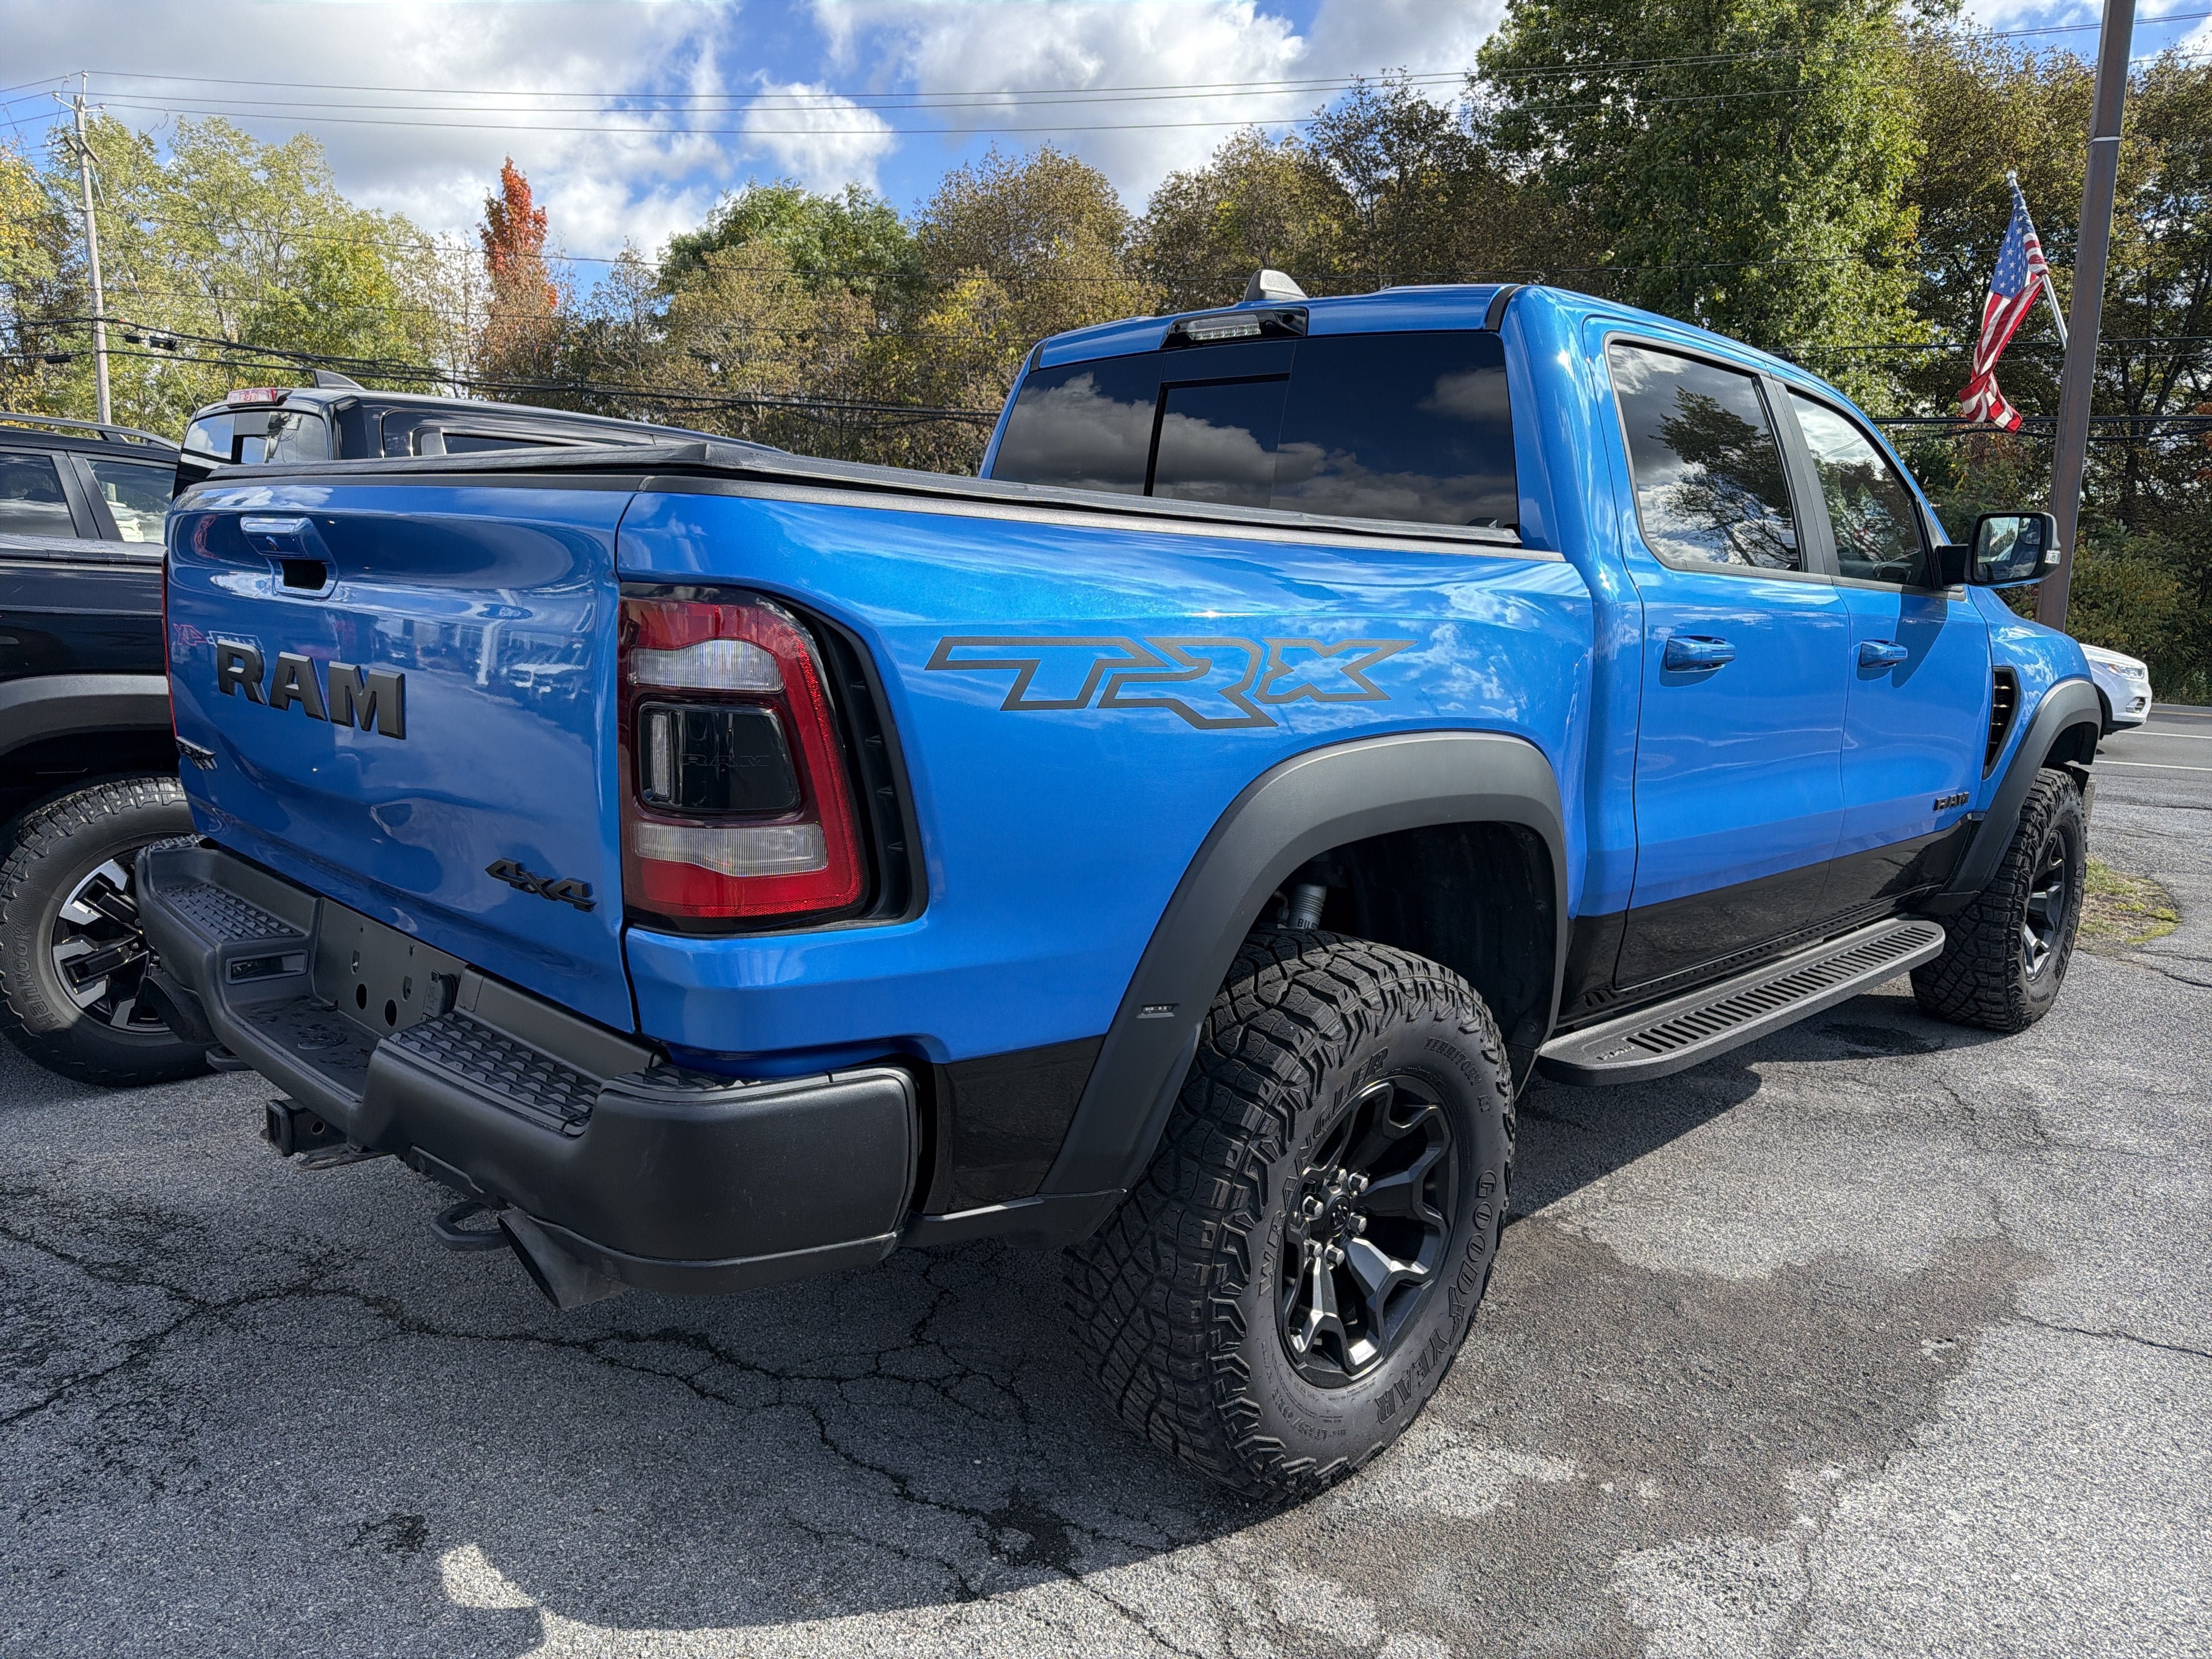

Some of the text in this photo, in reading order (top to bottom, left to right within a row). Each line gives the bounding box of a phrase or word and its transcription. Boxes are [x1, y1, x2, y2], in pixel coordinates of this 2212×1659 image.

[217, 639, 407, 740] RAM
[924, 636, 1418, 729] TRX
[680, 753, 769, 768] RAM
[1933, 791, 1970, 811] RAM
[2053, 860, 2084, 980] WRANGLER
[1424, 1036, 1482, 1086] TERRITORY
[1260, 1046, 1389, 1296] WRANGLER
[1375, 1170, 1497, 1424] GOODYEAR
